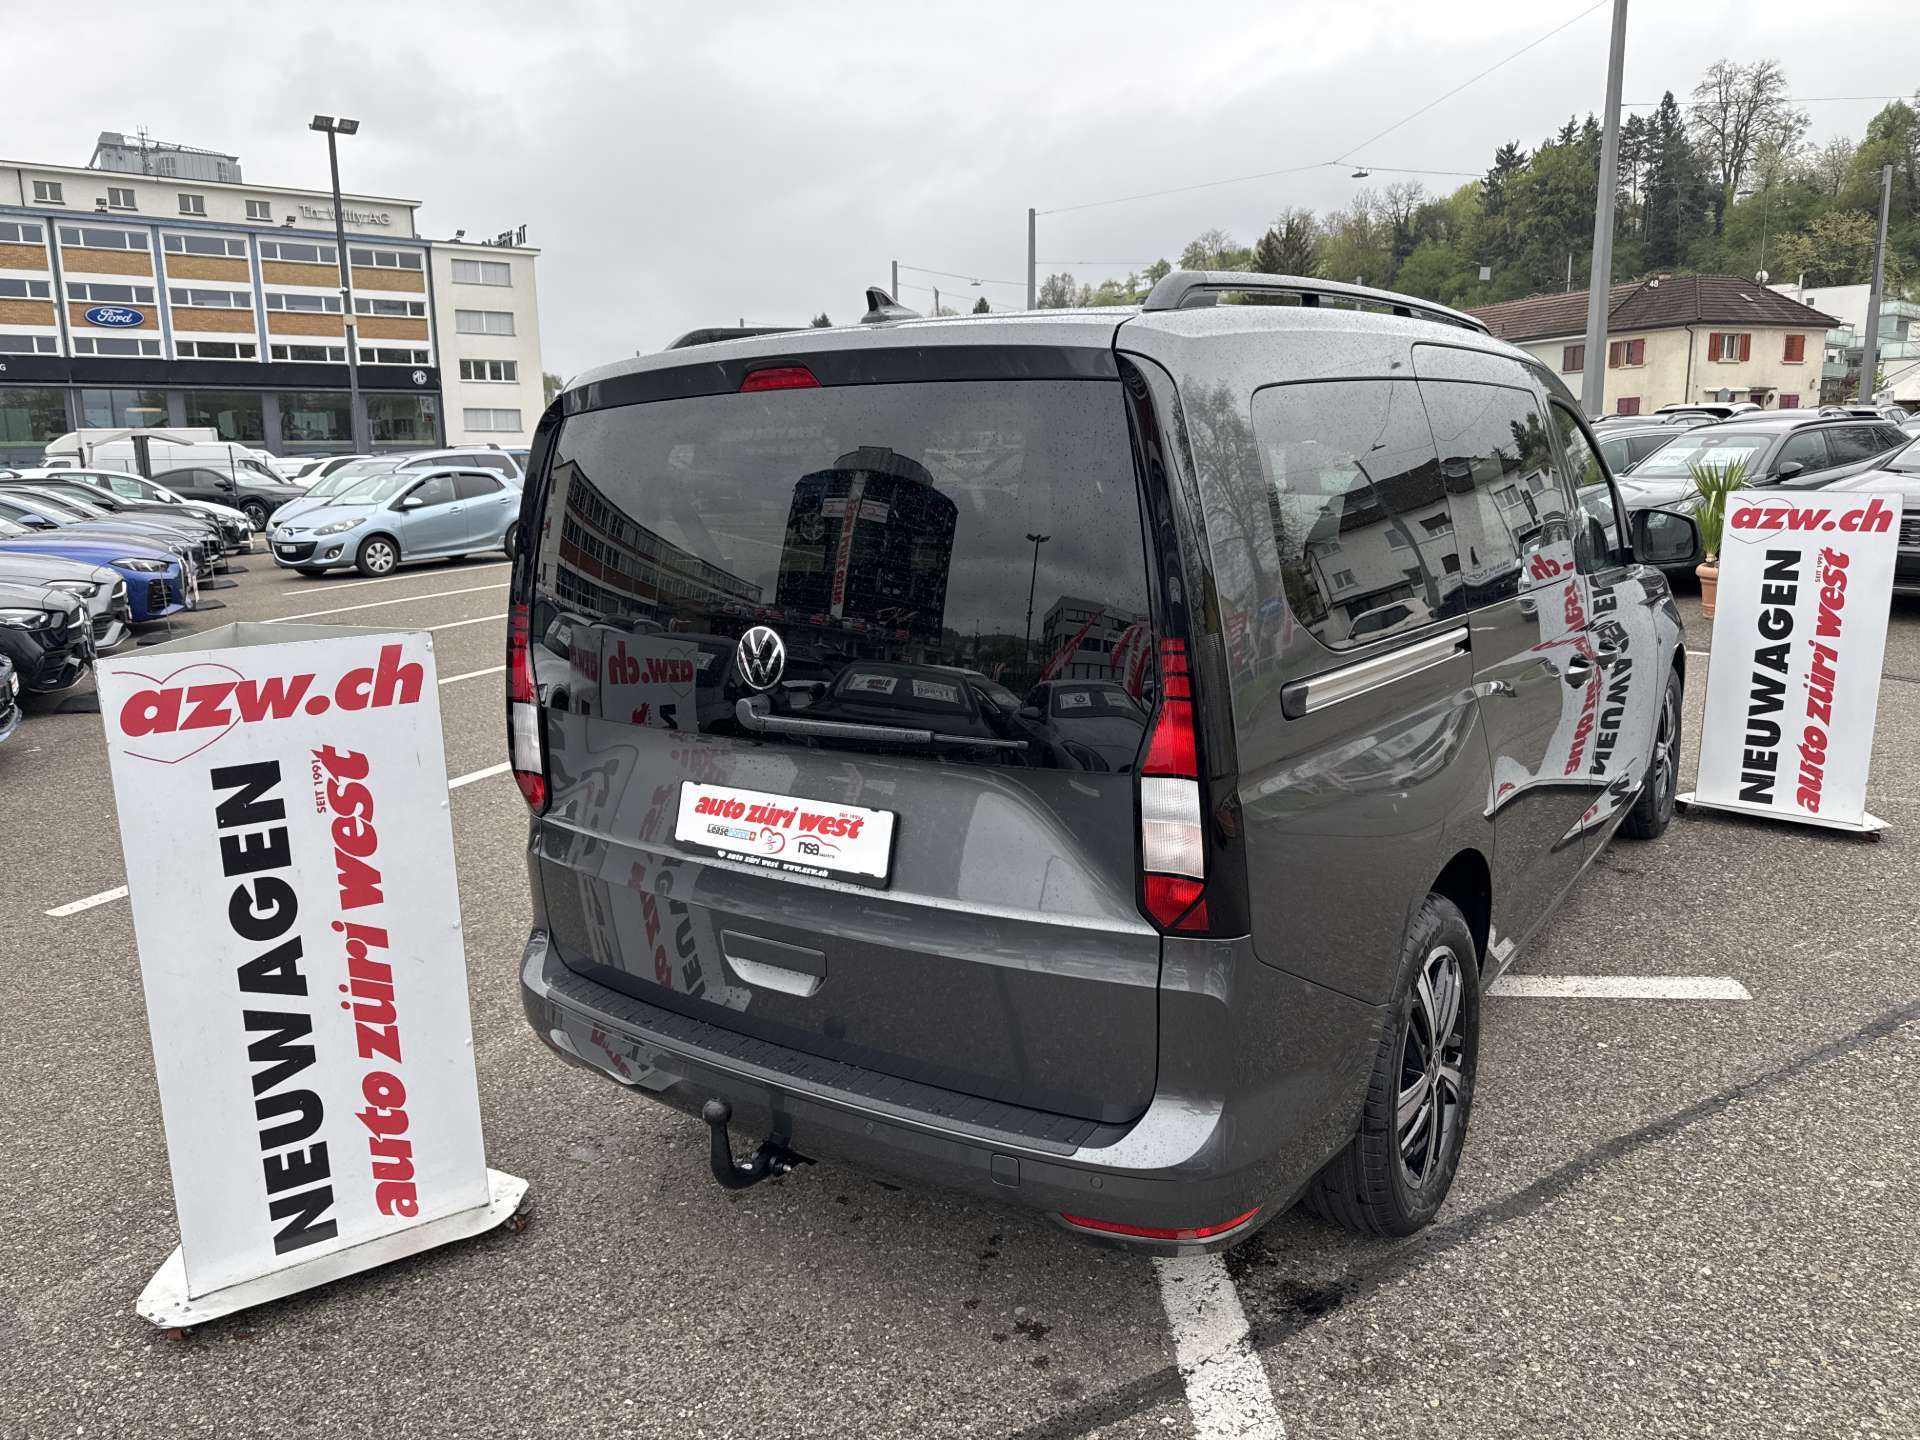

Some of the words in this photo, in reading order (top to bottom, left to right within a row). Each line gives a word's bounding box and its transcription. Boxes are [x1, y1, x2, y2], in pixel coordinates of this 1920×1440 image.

[368, 210, 392, 225] AG
[97, 308, 133, 323] Ford
[1731, 499, 1893, 533] azw.ch
[1815, 546, 1850, 638] west
[120, 644, 424, 738] azw.ch
[1738, 549, 1802, 804] NEUWAGEN
[1804, 641, 1838, 726] züri
[311, 760, 323, 786] 1991
[315, 790, 327, 814] SEIT
[1795, 725, 1828, 814] auto
[311, 744, 385, 911] west
[695, 796, 746, 819] auto
[744, 802, 799, 828] züri
[799, 813, 865, 839] west
[798, 841, 820, 856] nsa
[210, 759, 338, 1256] NEUWAGEN
[331, 920, 403, 1063] züri
[355, 1071, 419, 1218] auto
